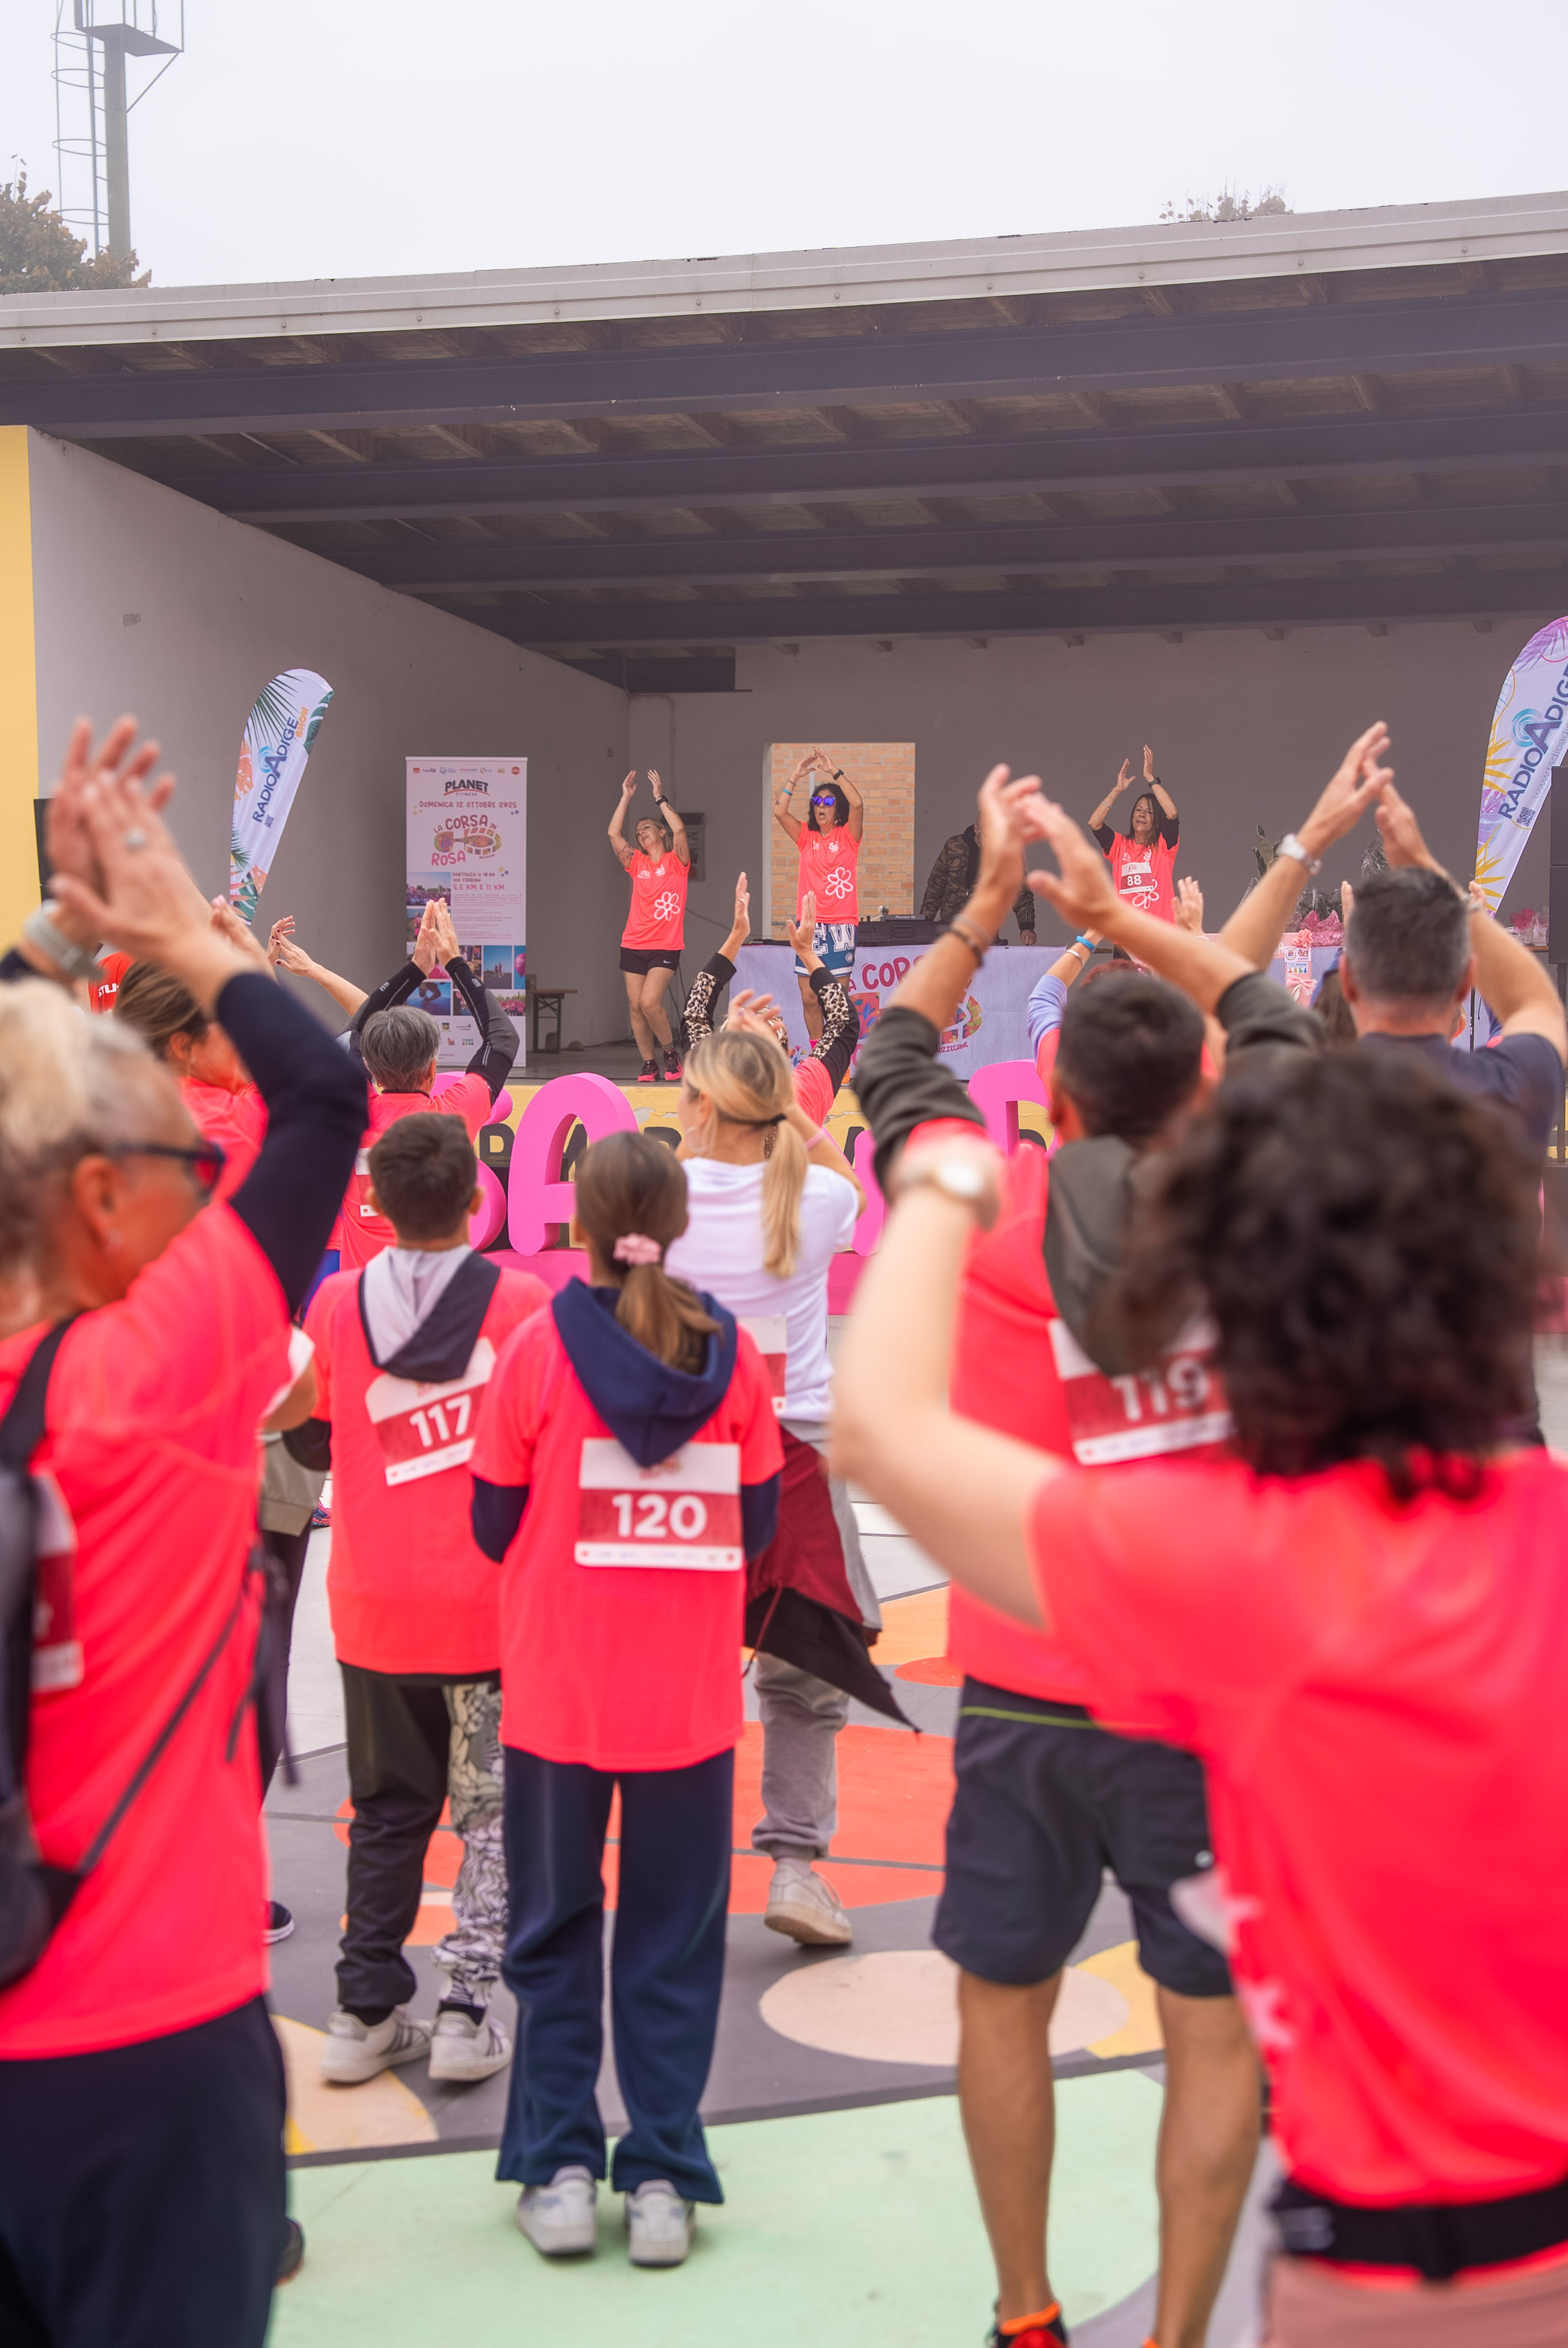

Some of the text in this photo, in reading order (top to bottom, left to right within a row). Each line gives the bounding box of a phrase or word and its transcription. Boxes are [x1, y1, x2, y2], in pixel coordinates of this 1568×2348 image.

[445, 780, 488, 792] PLANET
[433, 825, 443, 834] LA
[445, 815, 488, 829] CORSA
[431, 851, 465, 866] ROSA
[1127, 874, 1142, 886] 88
[1112, 1357, 1210, 1421] 119
[409, 1394, 471, 1447] 117
[611, 1493, 707, 1540] 120
